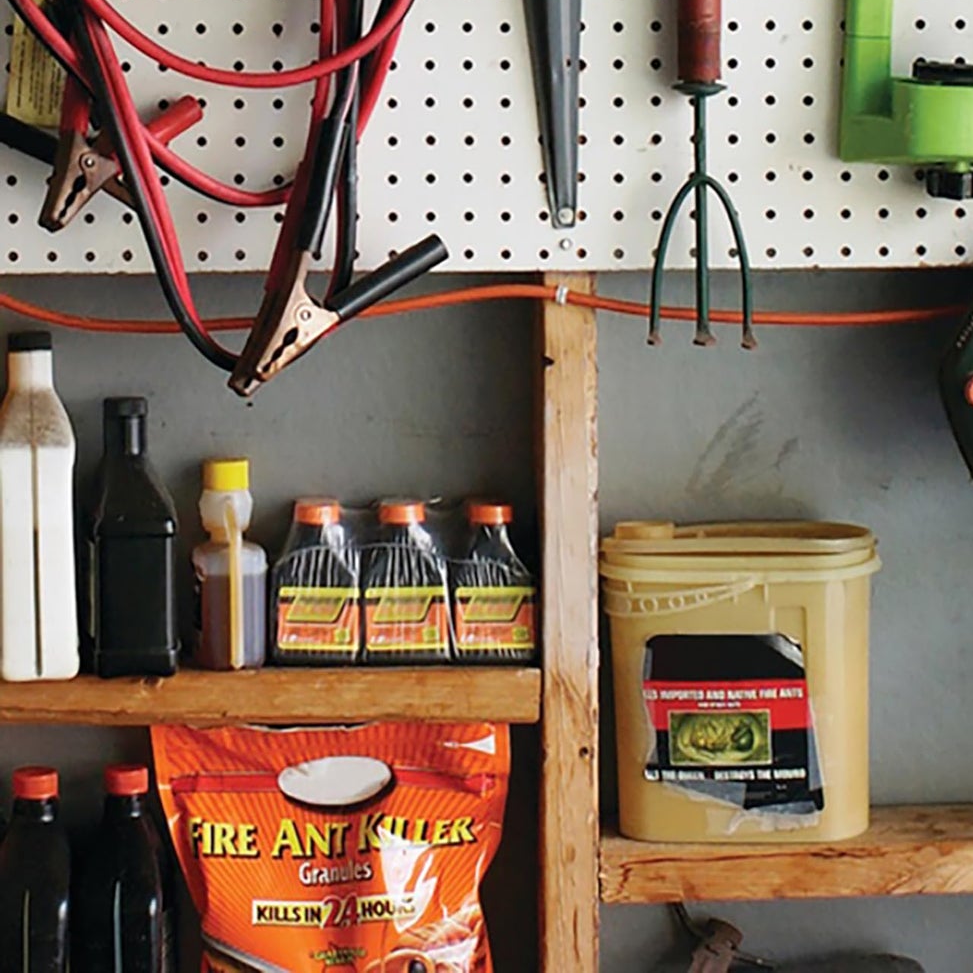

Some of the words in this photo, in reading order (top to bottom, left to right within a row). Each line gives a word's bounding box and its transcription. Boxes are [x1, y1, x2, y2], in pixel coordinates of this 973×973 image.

[660, 688, 705, 700] IMPORTED
[706, 688, 725, 700] AND
[727, 688, 757, 700] NATIVE
[759, 688, 778, 699] FIRE
[779, 687, 804, 699] ANTS
[756, 768, 772, 780] THE
[189, 817, 258, 856] FIRE
[272, 818, 350, 857] ANT
[359, 812, 476, 852] KILLER
[299, 860, 373, 884] Granules
[257, 903, 301, 923] KILLS
[302, 902, 322, 922] IN
[322, 895, 359, 928] 24
